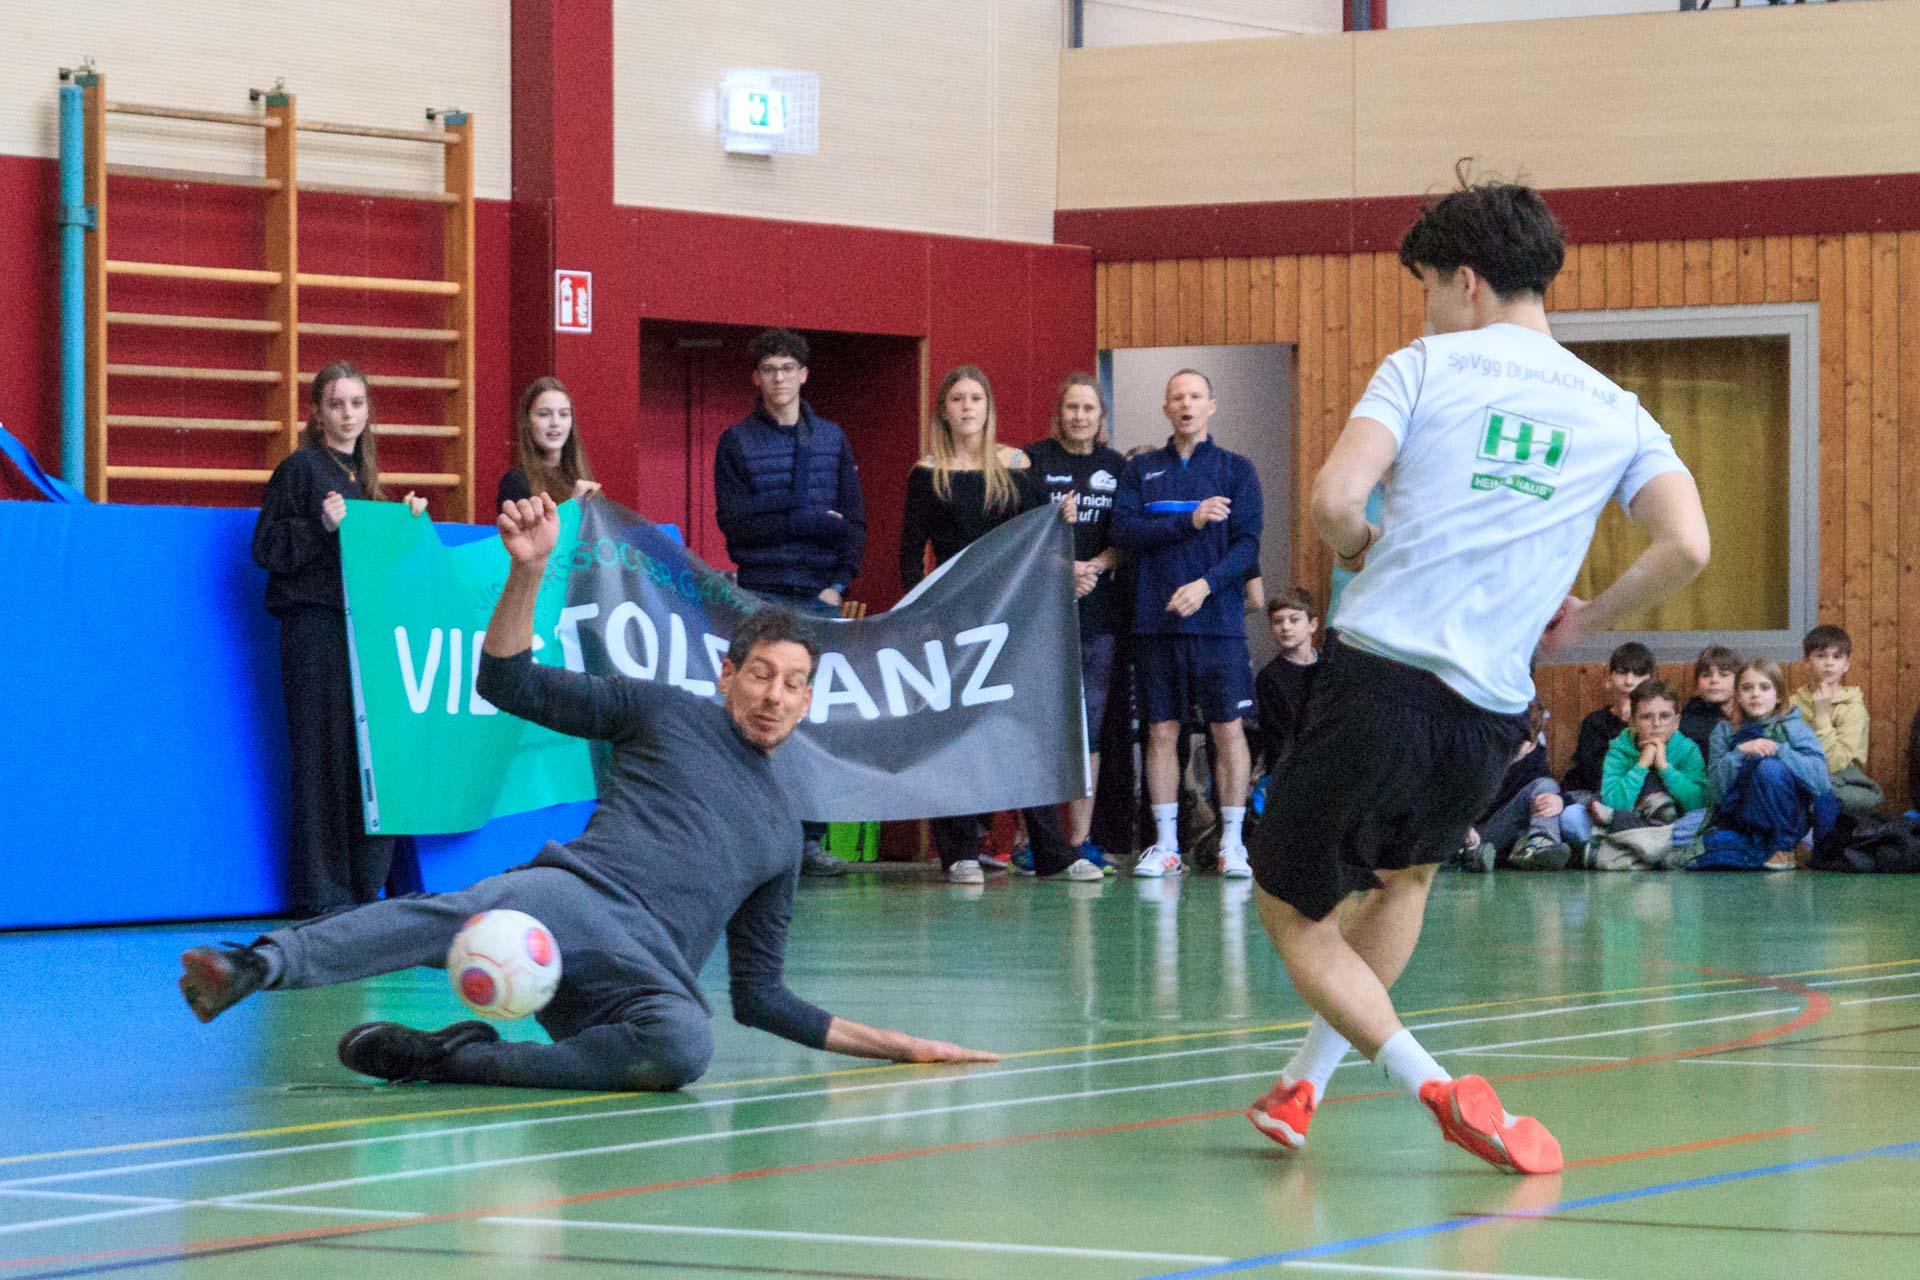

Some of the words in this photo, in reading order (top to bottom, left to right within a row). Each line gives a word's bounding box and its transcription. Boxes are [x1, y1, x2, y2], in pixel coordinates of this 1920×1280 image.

[1448, 352, 1503, 378] SpVgg
[1515, 478, 1548, 497] HAUS
[555, 600, 1014, 724] TOLANZ
